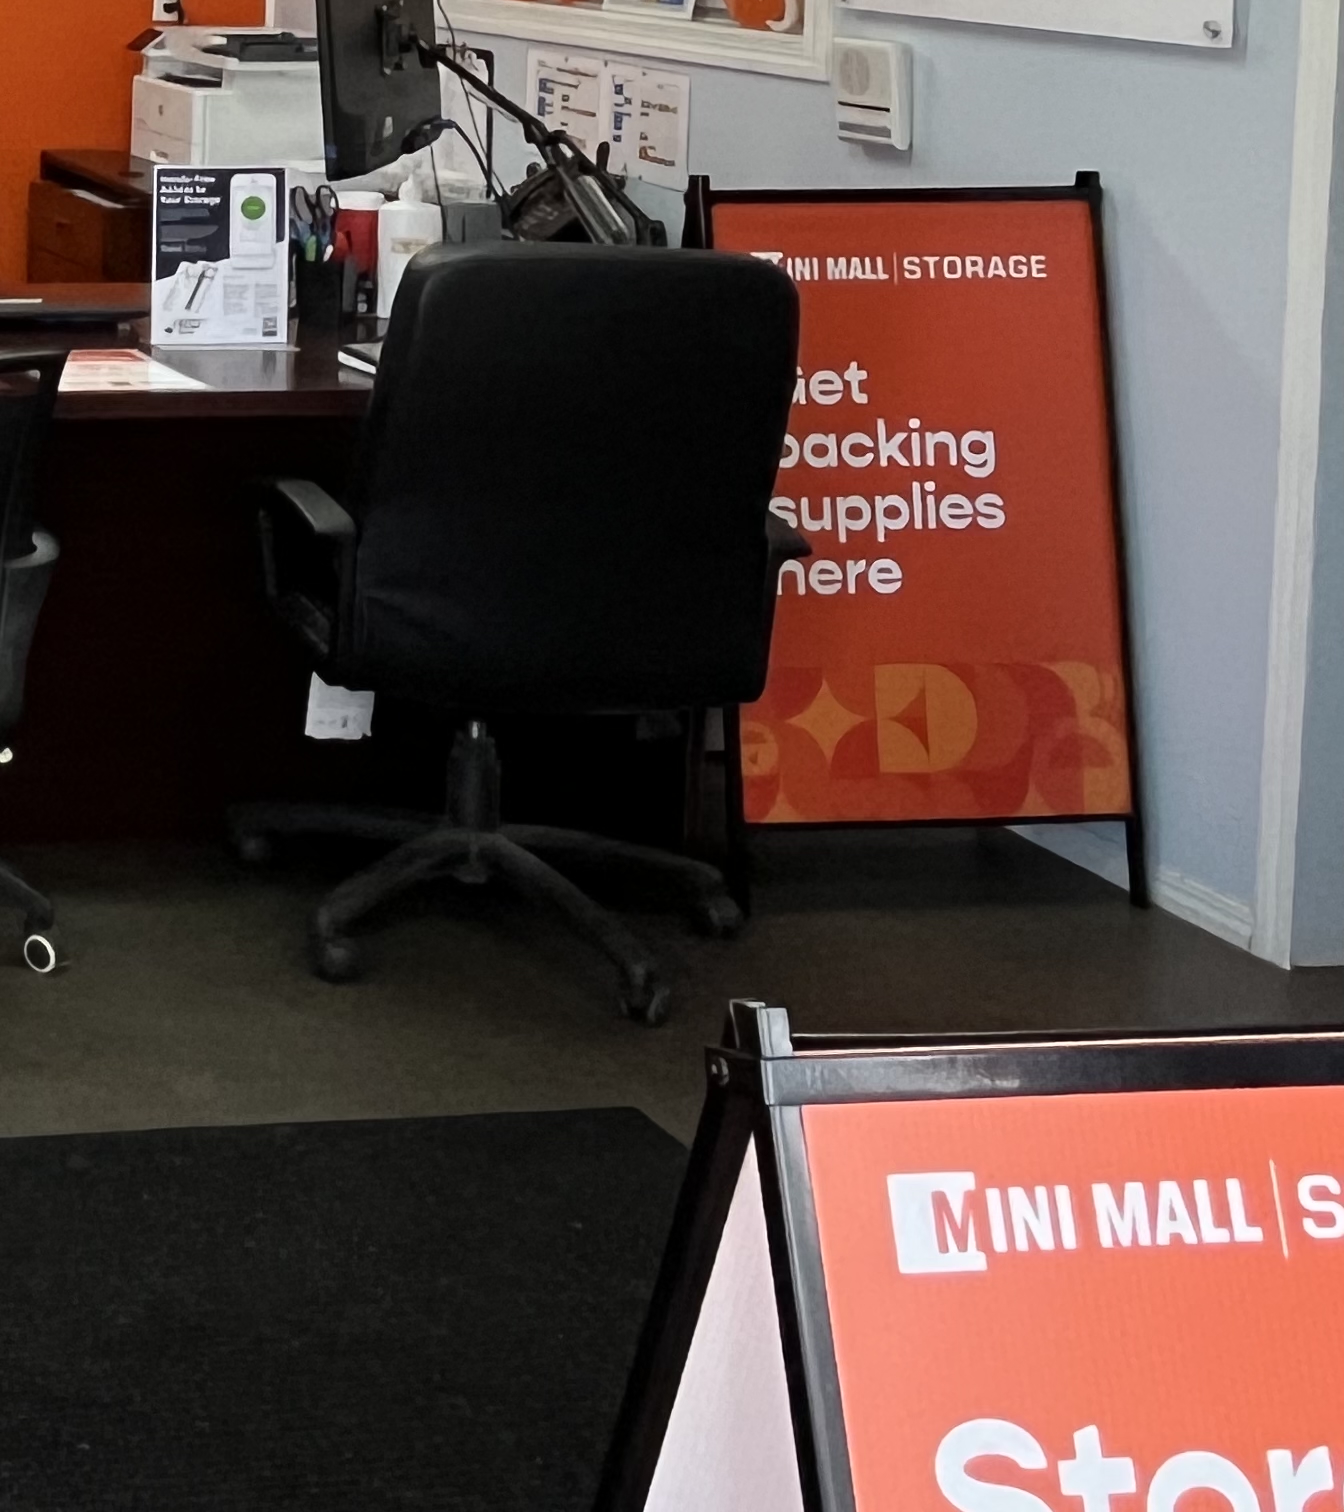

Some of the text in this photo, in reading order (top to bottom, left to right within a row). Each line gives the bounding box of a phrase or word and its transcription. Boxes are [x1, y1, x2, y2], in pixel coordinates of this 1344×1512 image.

[767, 253, 1048, 281] INI MALL STORAGE
[768, 480, 1007, 544] supplies
[928, 1179, 1079, 1257] MINI
[1091, 1177, 1264, 1249] MALL
[934, 1417, 1344, 1512] Stor
